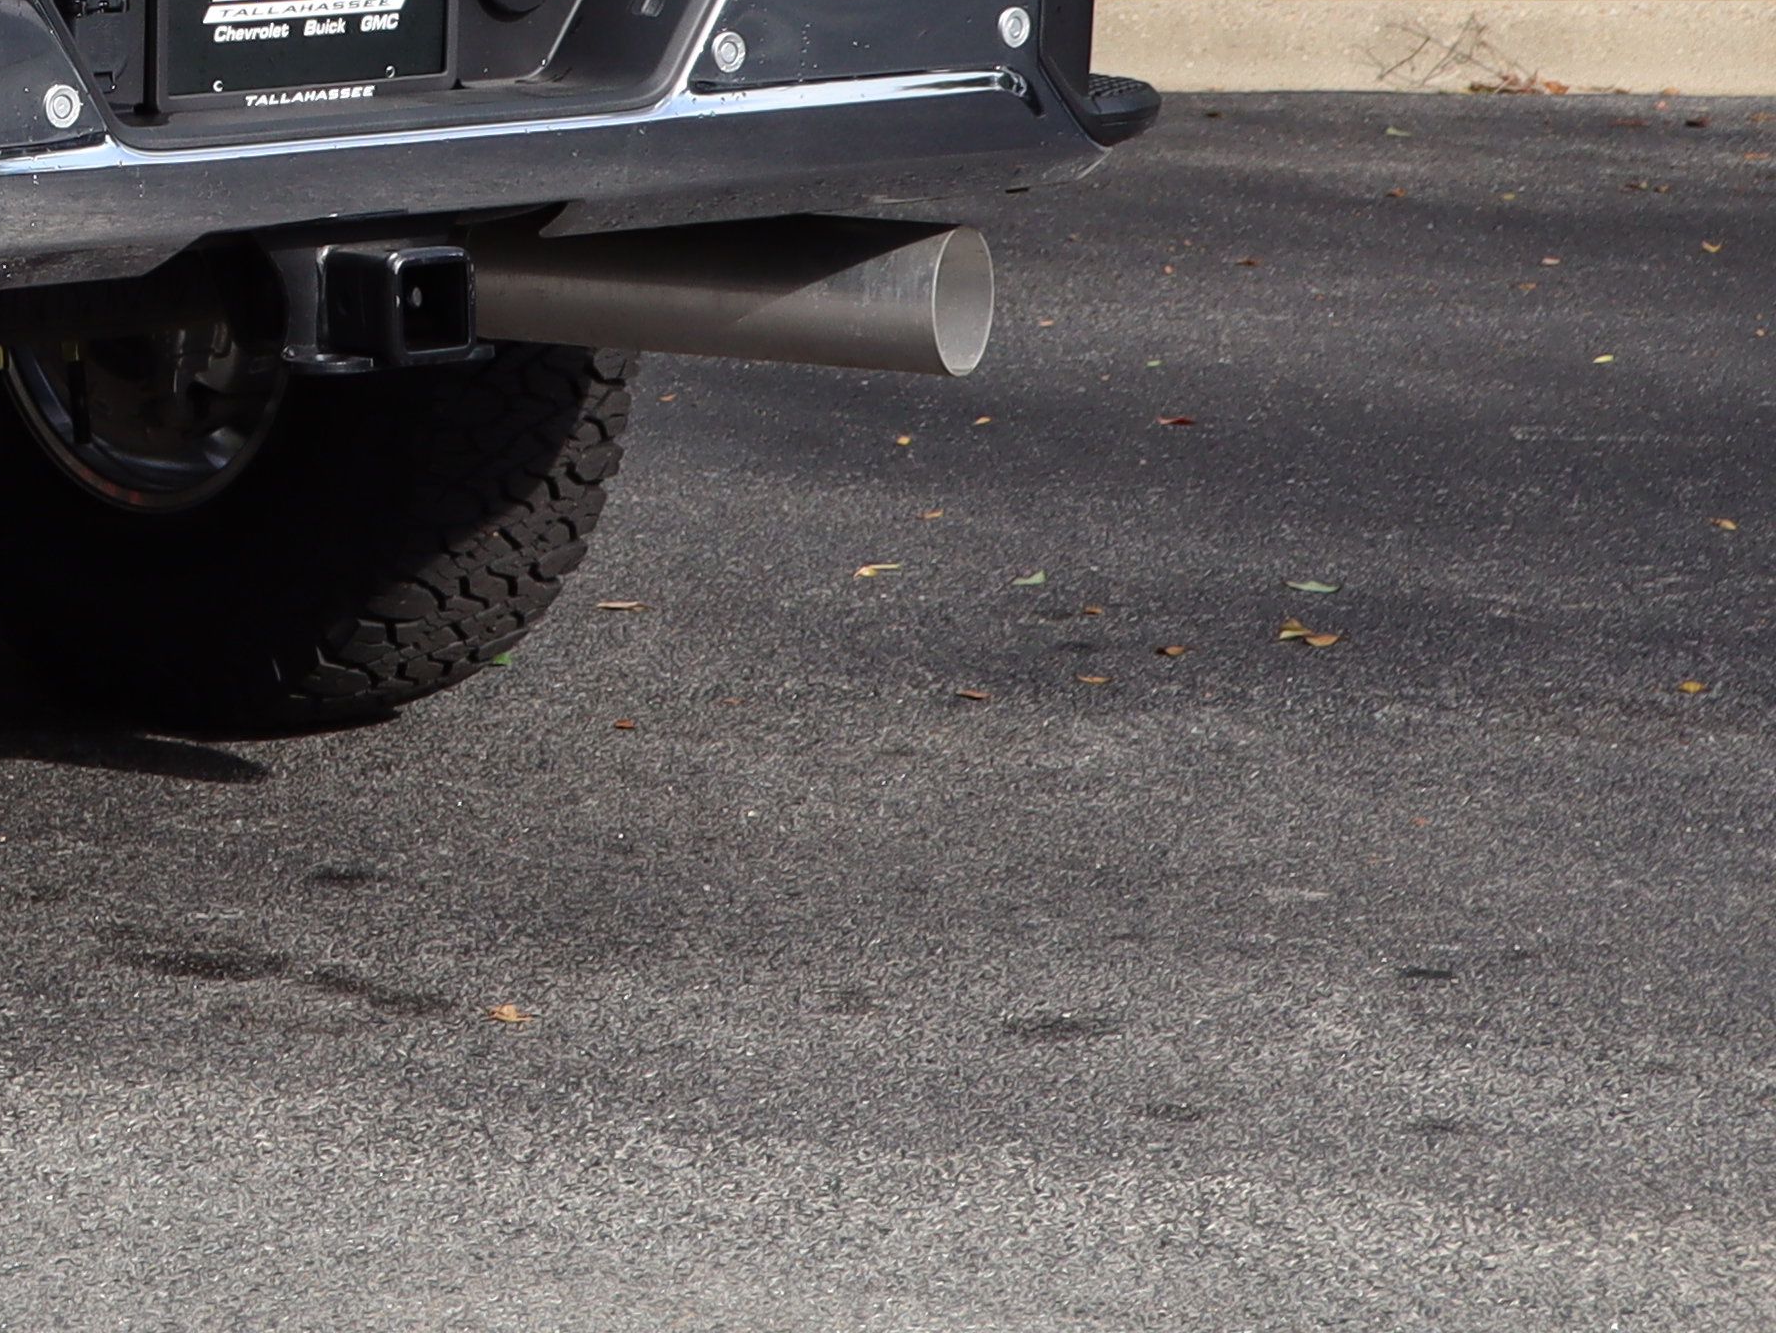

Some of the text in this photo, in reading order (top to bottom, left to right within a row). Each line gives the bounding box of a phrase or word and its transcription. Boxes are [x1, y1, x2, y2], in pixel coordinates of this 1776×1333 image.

[213, 13, 399, 43] Chevrolet Buick GMC
[245, 85, 376, 107] TALLAHASSEE
